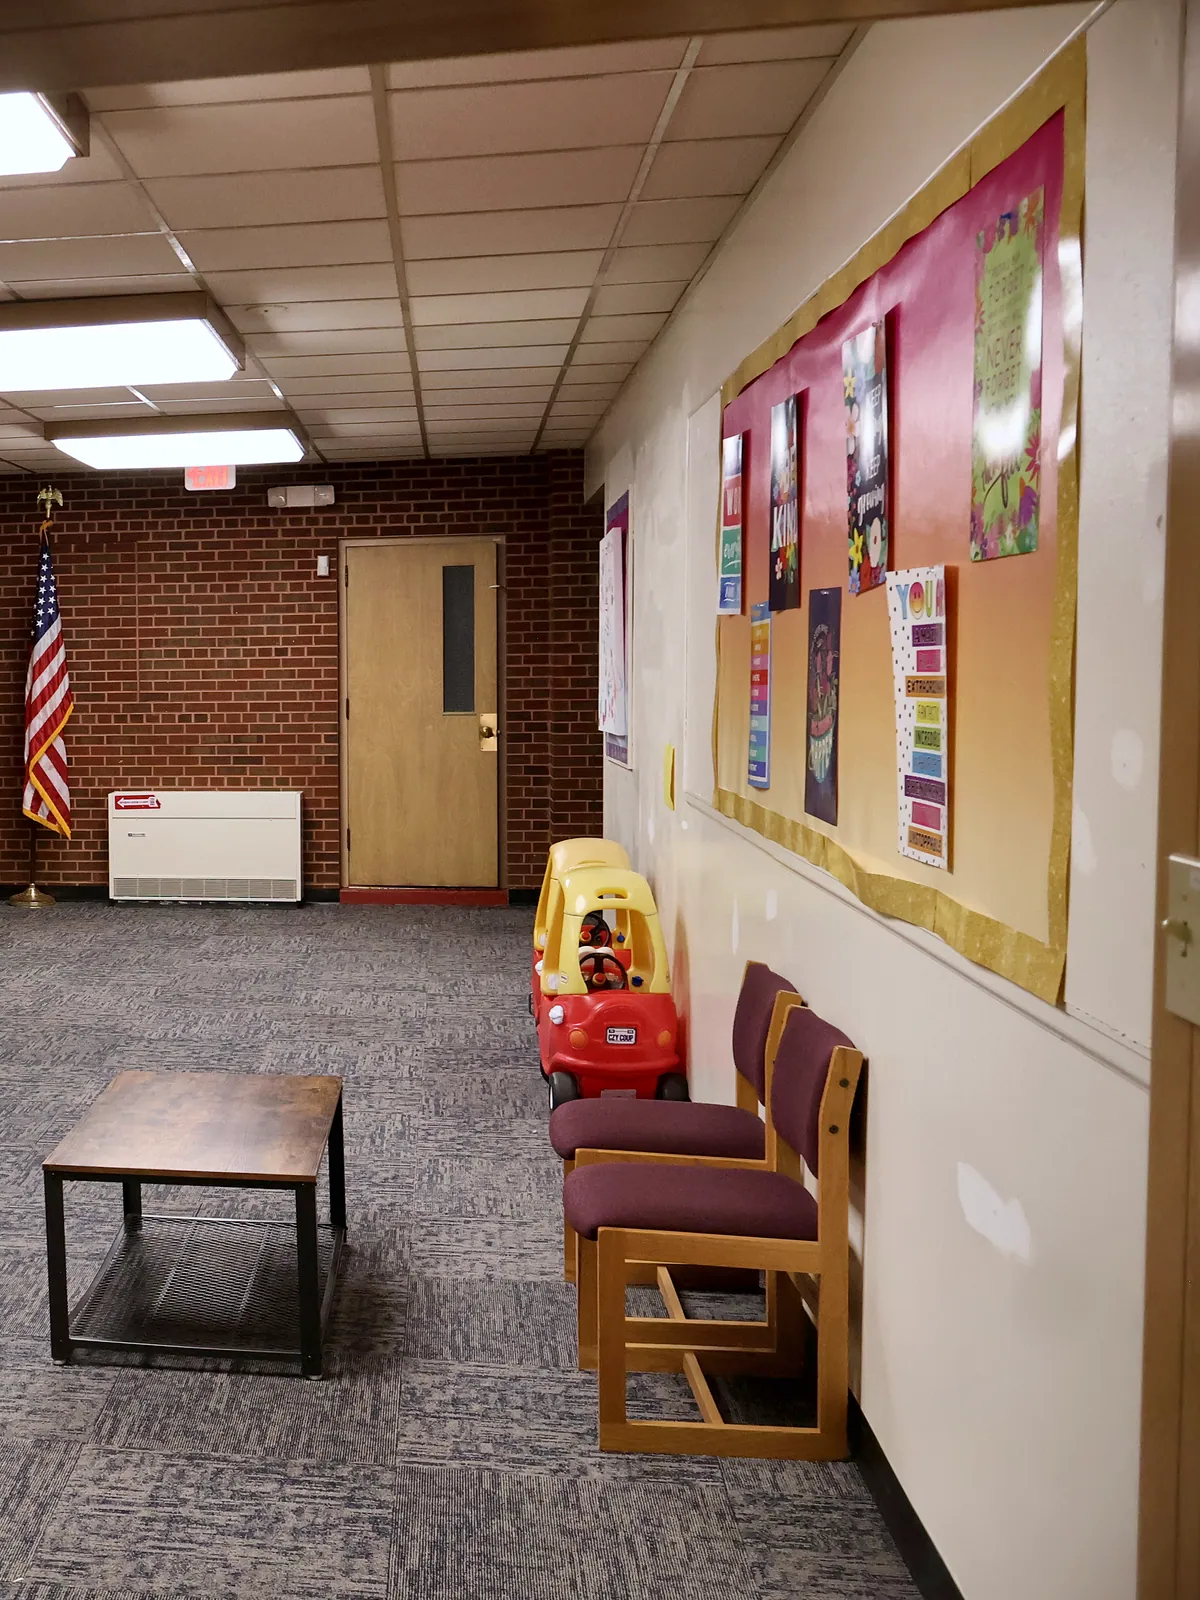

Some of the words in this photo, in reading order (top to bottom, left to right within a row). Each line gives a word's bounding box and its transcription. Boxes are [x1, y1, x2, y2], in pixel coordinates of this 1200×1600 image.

[986, 325, 1022, 372] NEVER
[608, 1034, 619, 1042] CZY
[620, 1034, 634, 1042] COUP
